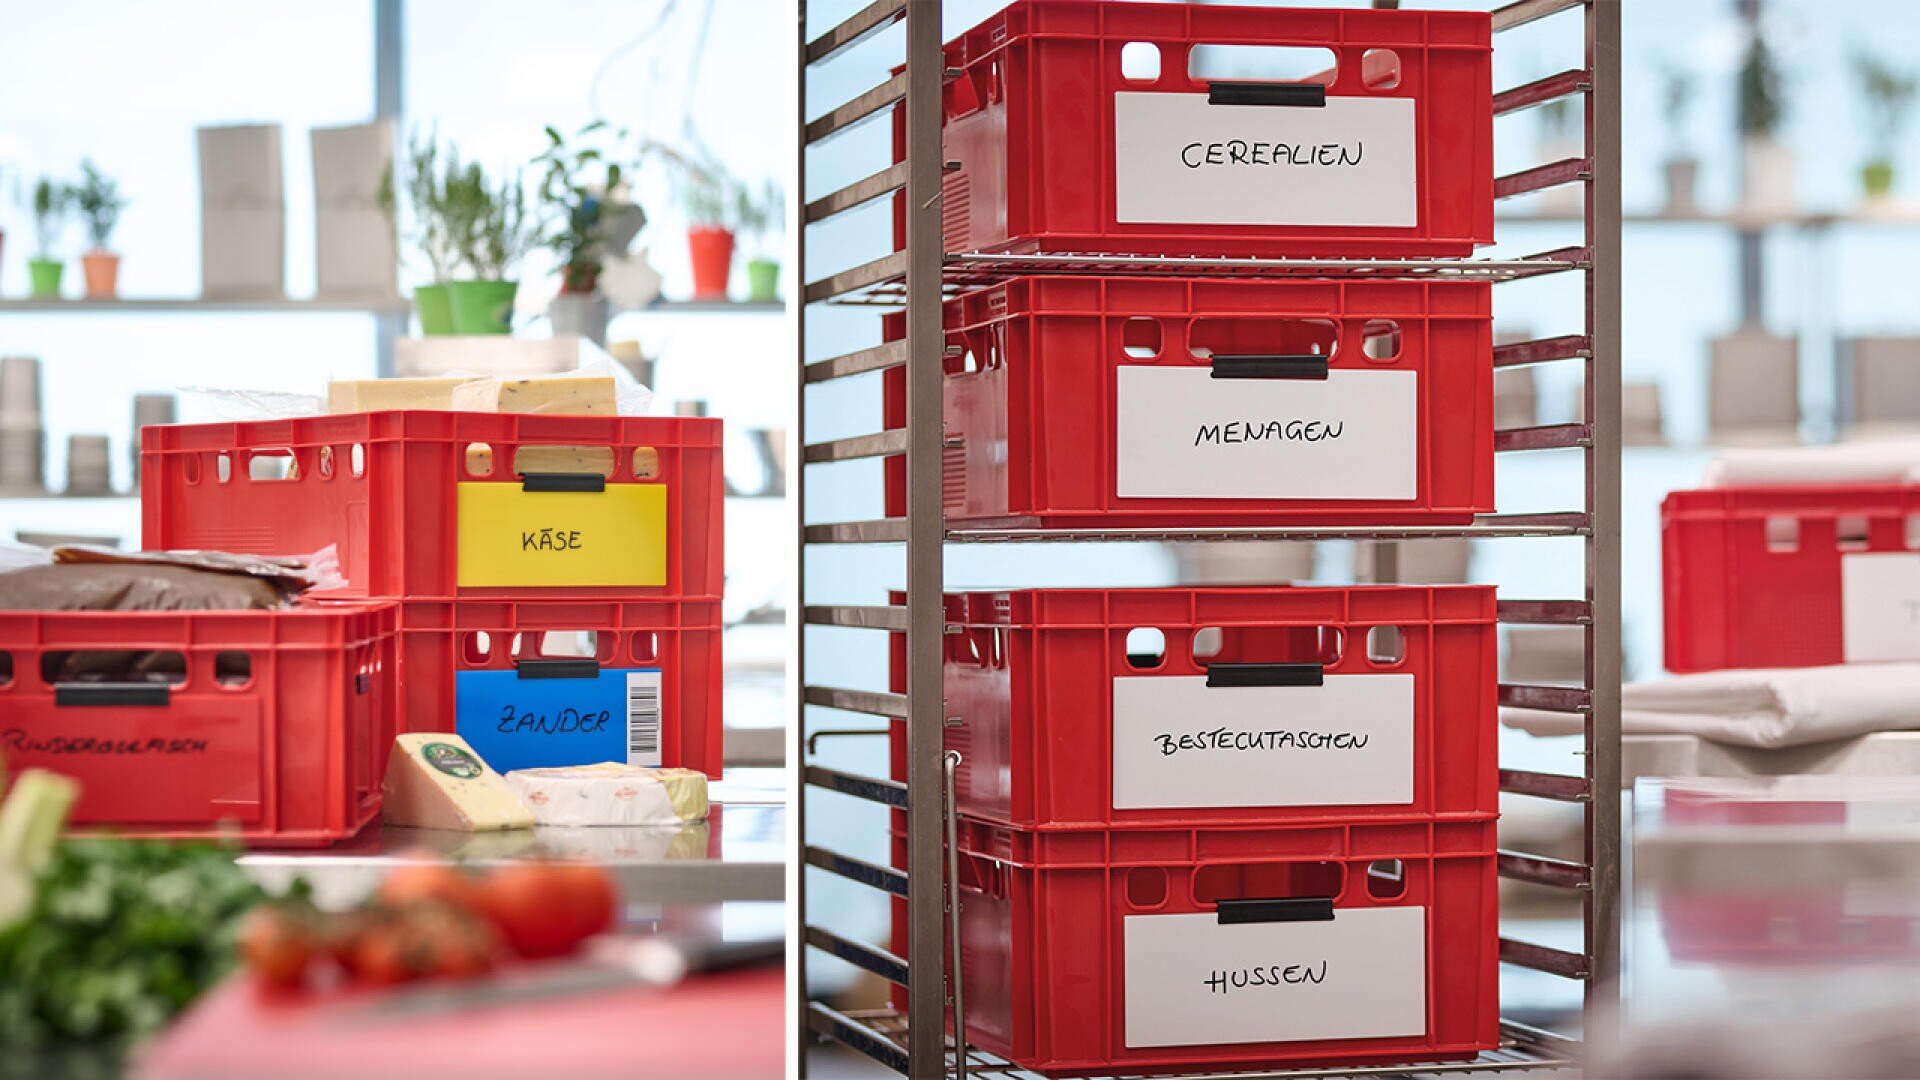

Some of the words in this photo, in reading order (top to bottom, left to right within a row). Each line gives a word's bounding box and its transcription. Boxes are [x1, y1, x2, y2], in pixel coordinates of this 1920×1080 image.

[1181, 138, 1363, 168] CEREALIEN
[1194, 420, 1344, 447] MENAGEN
[521, 527, 583, 552] KÄSE
[496, 704, 611, 735] ZANDER
[1203, 959, 1327, 994] HUSSEN
